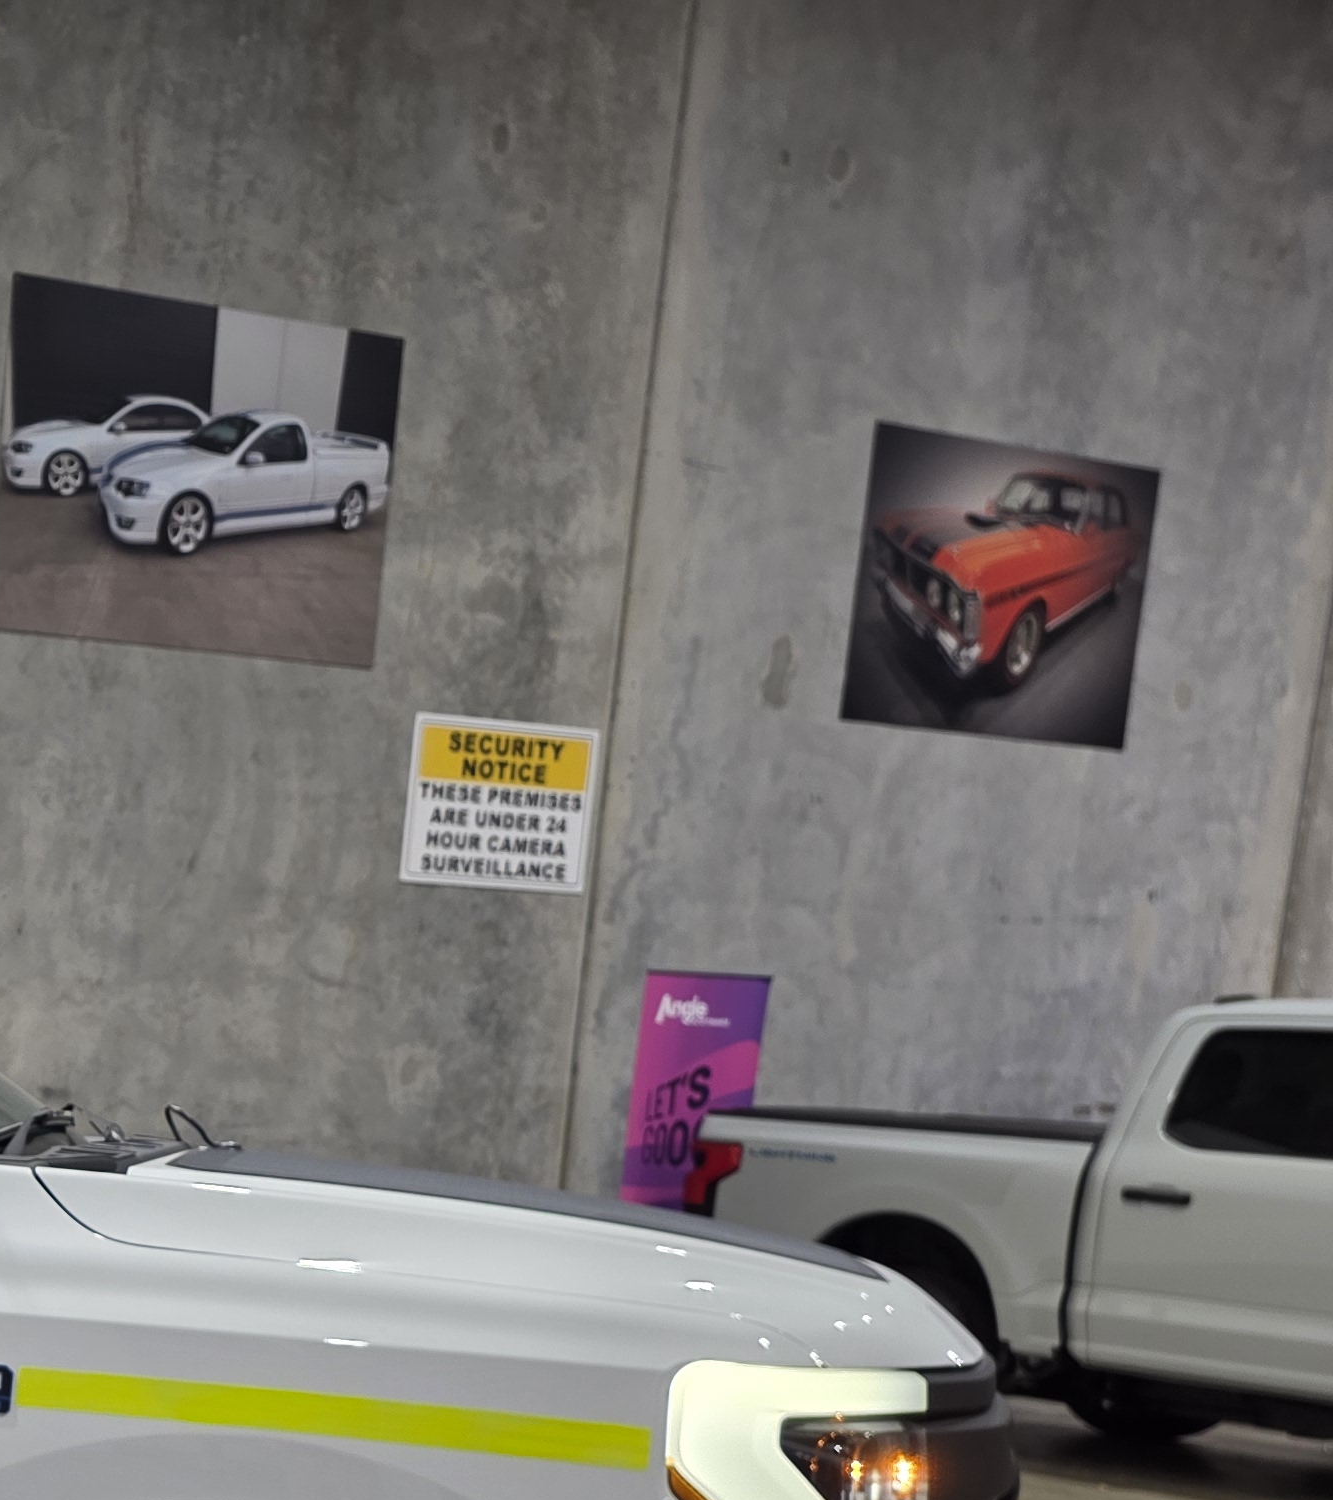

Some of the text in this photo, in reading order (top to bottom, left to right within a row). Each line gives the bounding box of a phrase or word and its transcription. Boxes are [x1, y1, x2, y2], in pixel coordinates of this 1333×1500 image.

[448, 730, 564, 762] SECURITY
[462, 758, 547, 784] NOTICE
[420, 781, 582, 812] THESE PREMISES
[430, 807, 567, 834] ARE UNDER 24
[426, 830, 565, 857] HOUR CAMERA
[421, 853, 566, 881] SURVEILLANCE
[645, 1065, 711, 1121] LET'S
[641, 1113, 702, 1167] GOO
